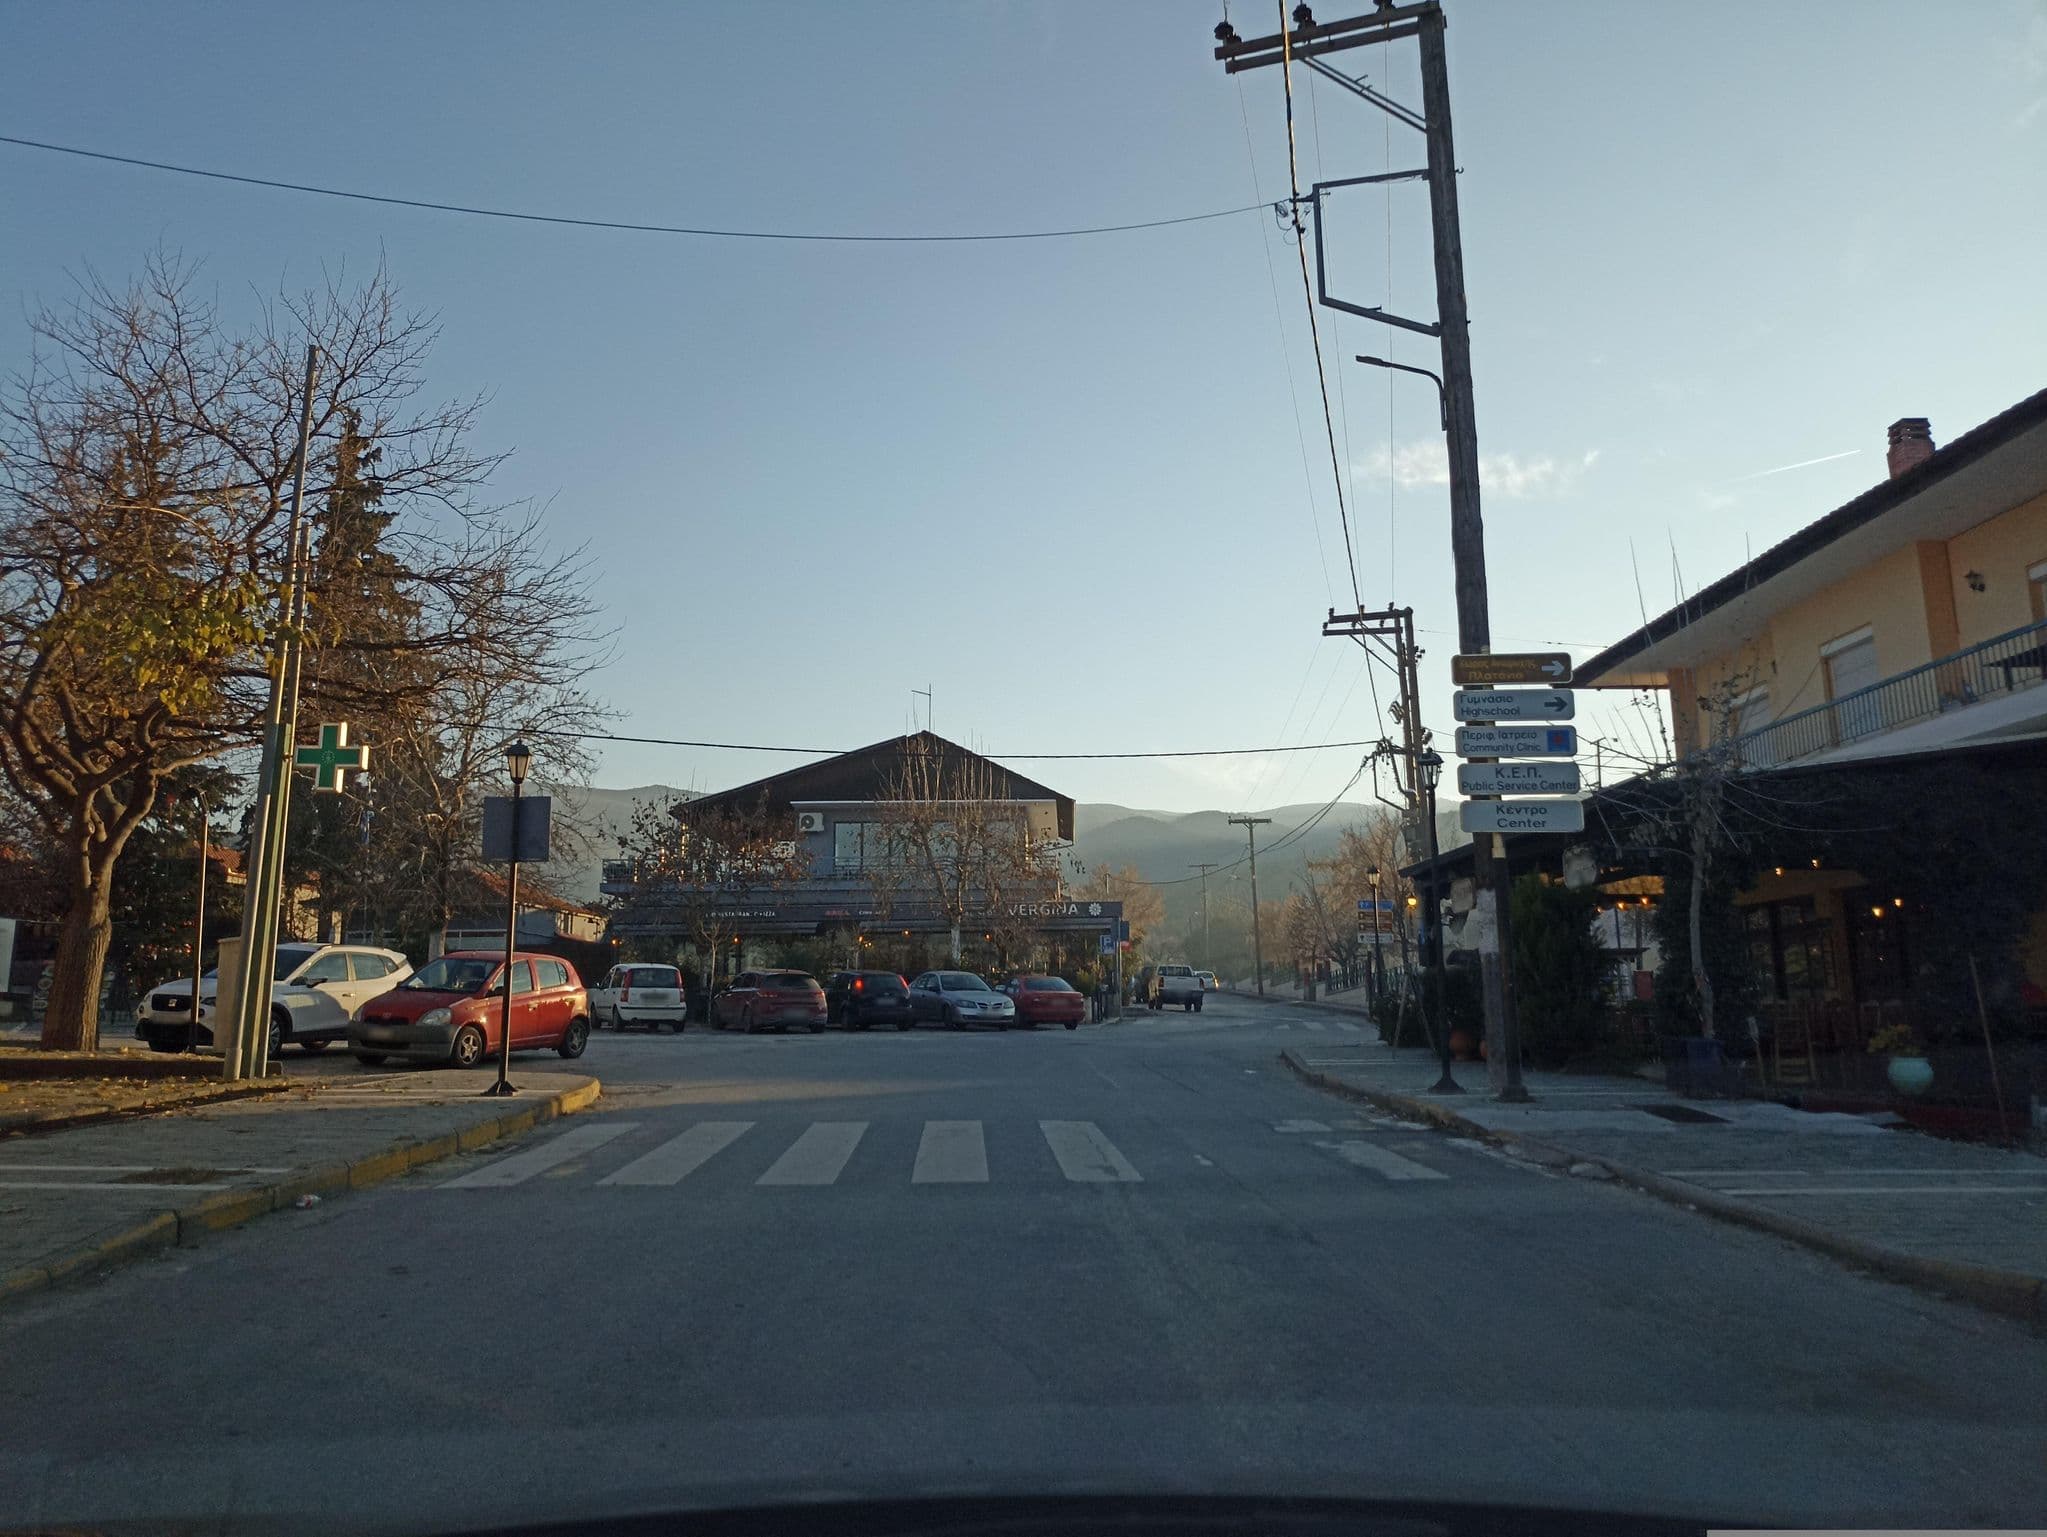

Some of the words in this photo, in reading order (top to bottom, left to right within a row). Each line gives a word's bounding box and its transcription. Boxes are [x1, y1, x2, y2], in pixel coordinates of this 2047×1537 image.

[1461, 706, 1521, 717] Highschool
[1463, 742, 1514, 754] Community
[1516, 742, 1542, 753] Clinic
[1463, 781, 1495, 791] Public
[1497, 781, 1538, 791] Service
[1540, 780, 1577, 791] Center
[1497, 818, 1548, 829] Center
